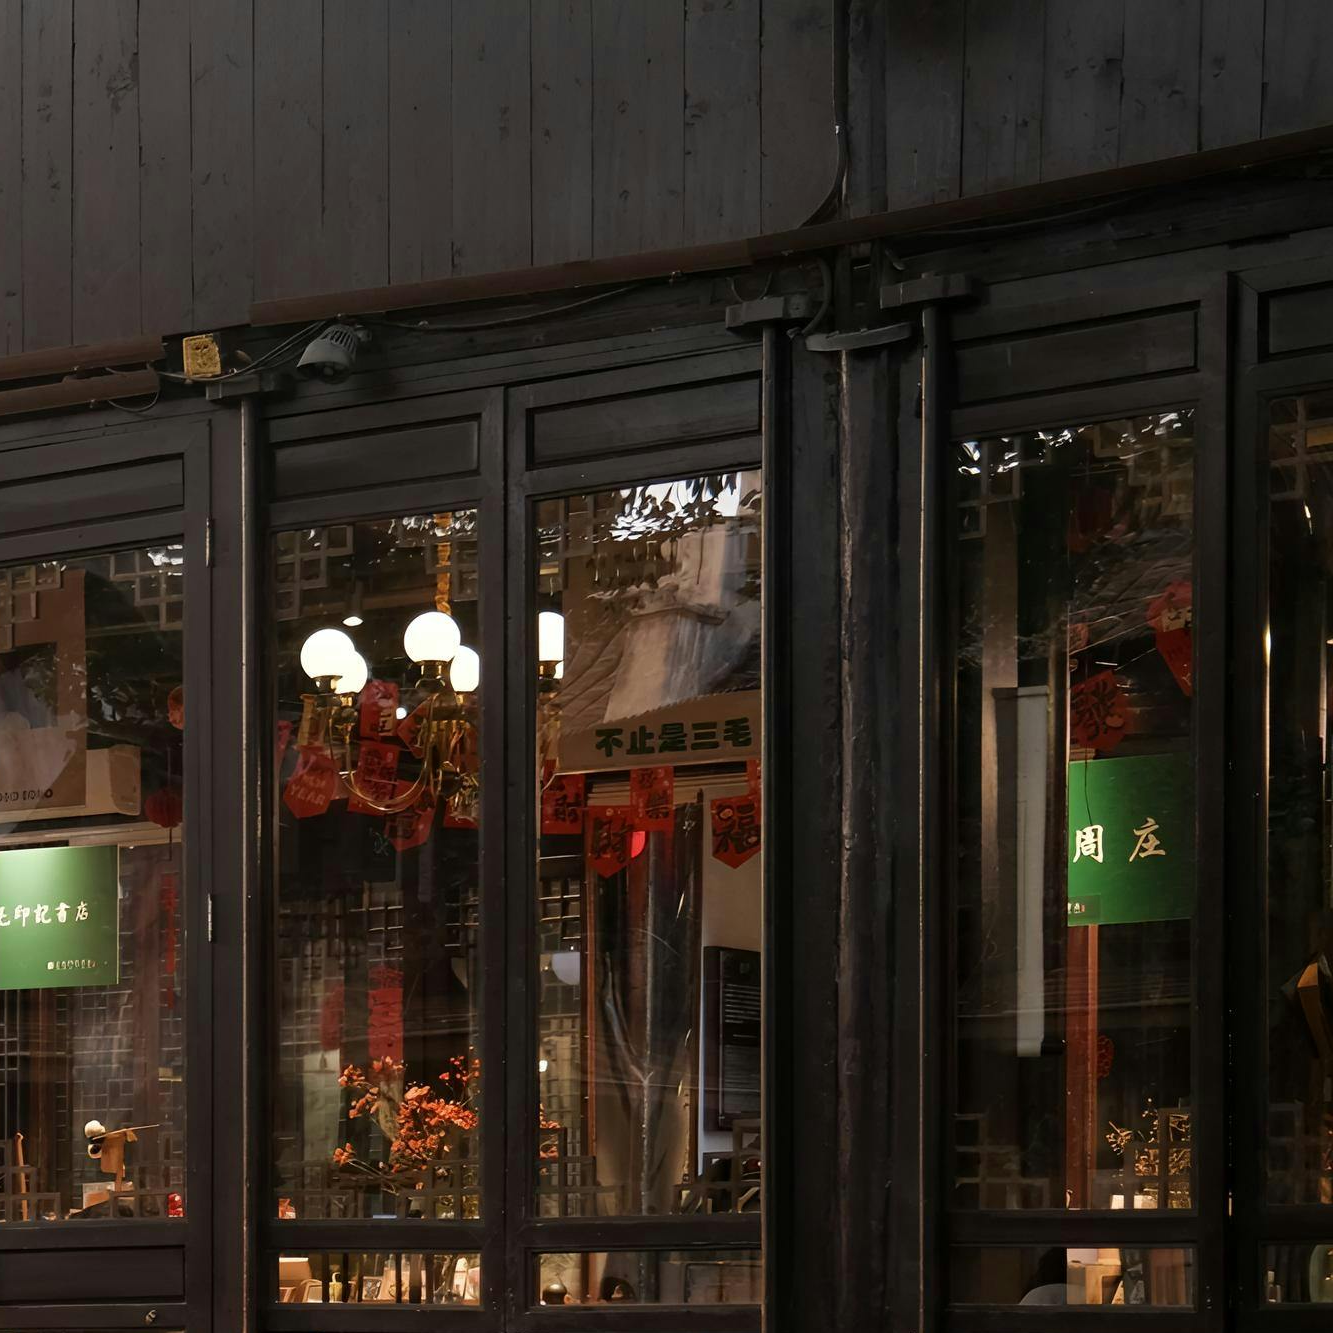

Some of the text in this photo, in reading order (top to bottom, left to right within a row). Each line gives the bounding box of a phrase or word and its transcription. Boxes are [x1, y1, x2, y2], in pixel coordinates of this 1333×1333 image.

[595, 716, 753, 758] 不止是三毛
[1072, 817, 1167, 864] 周庄
